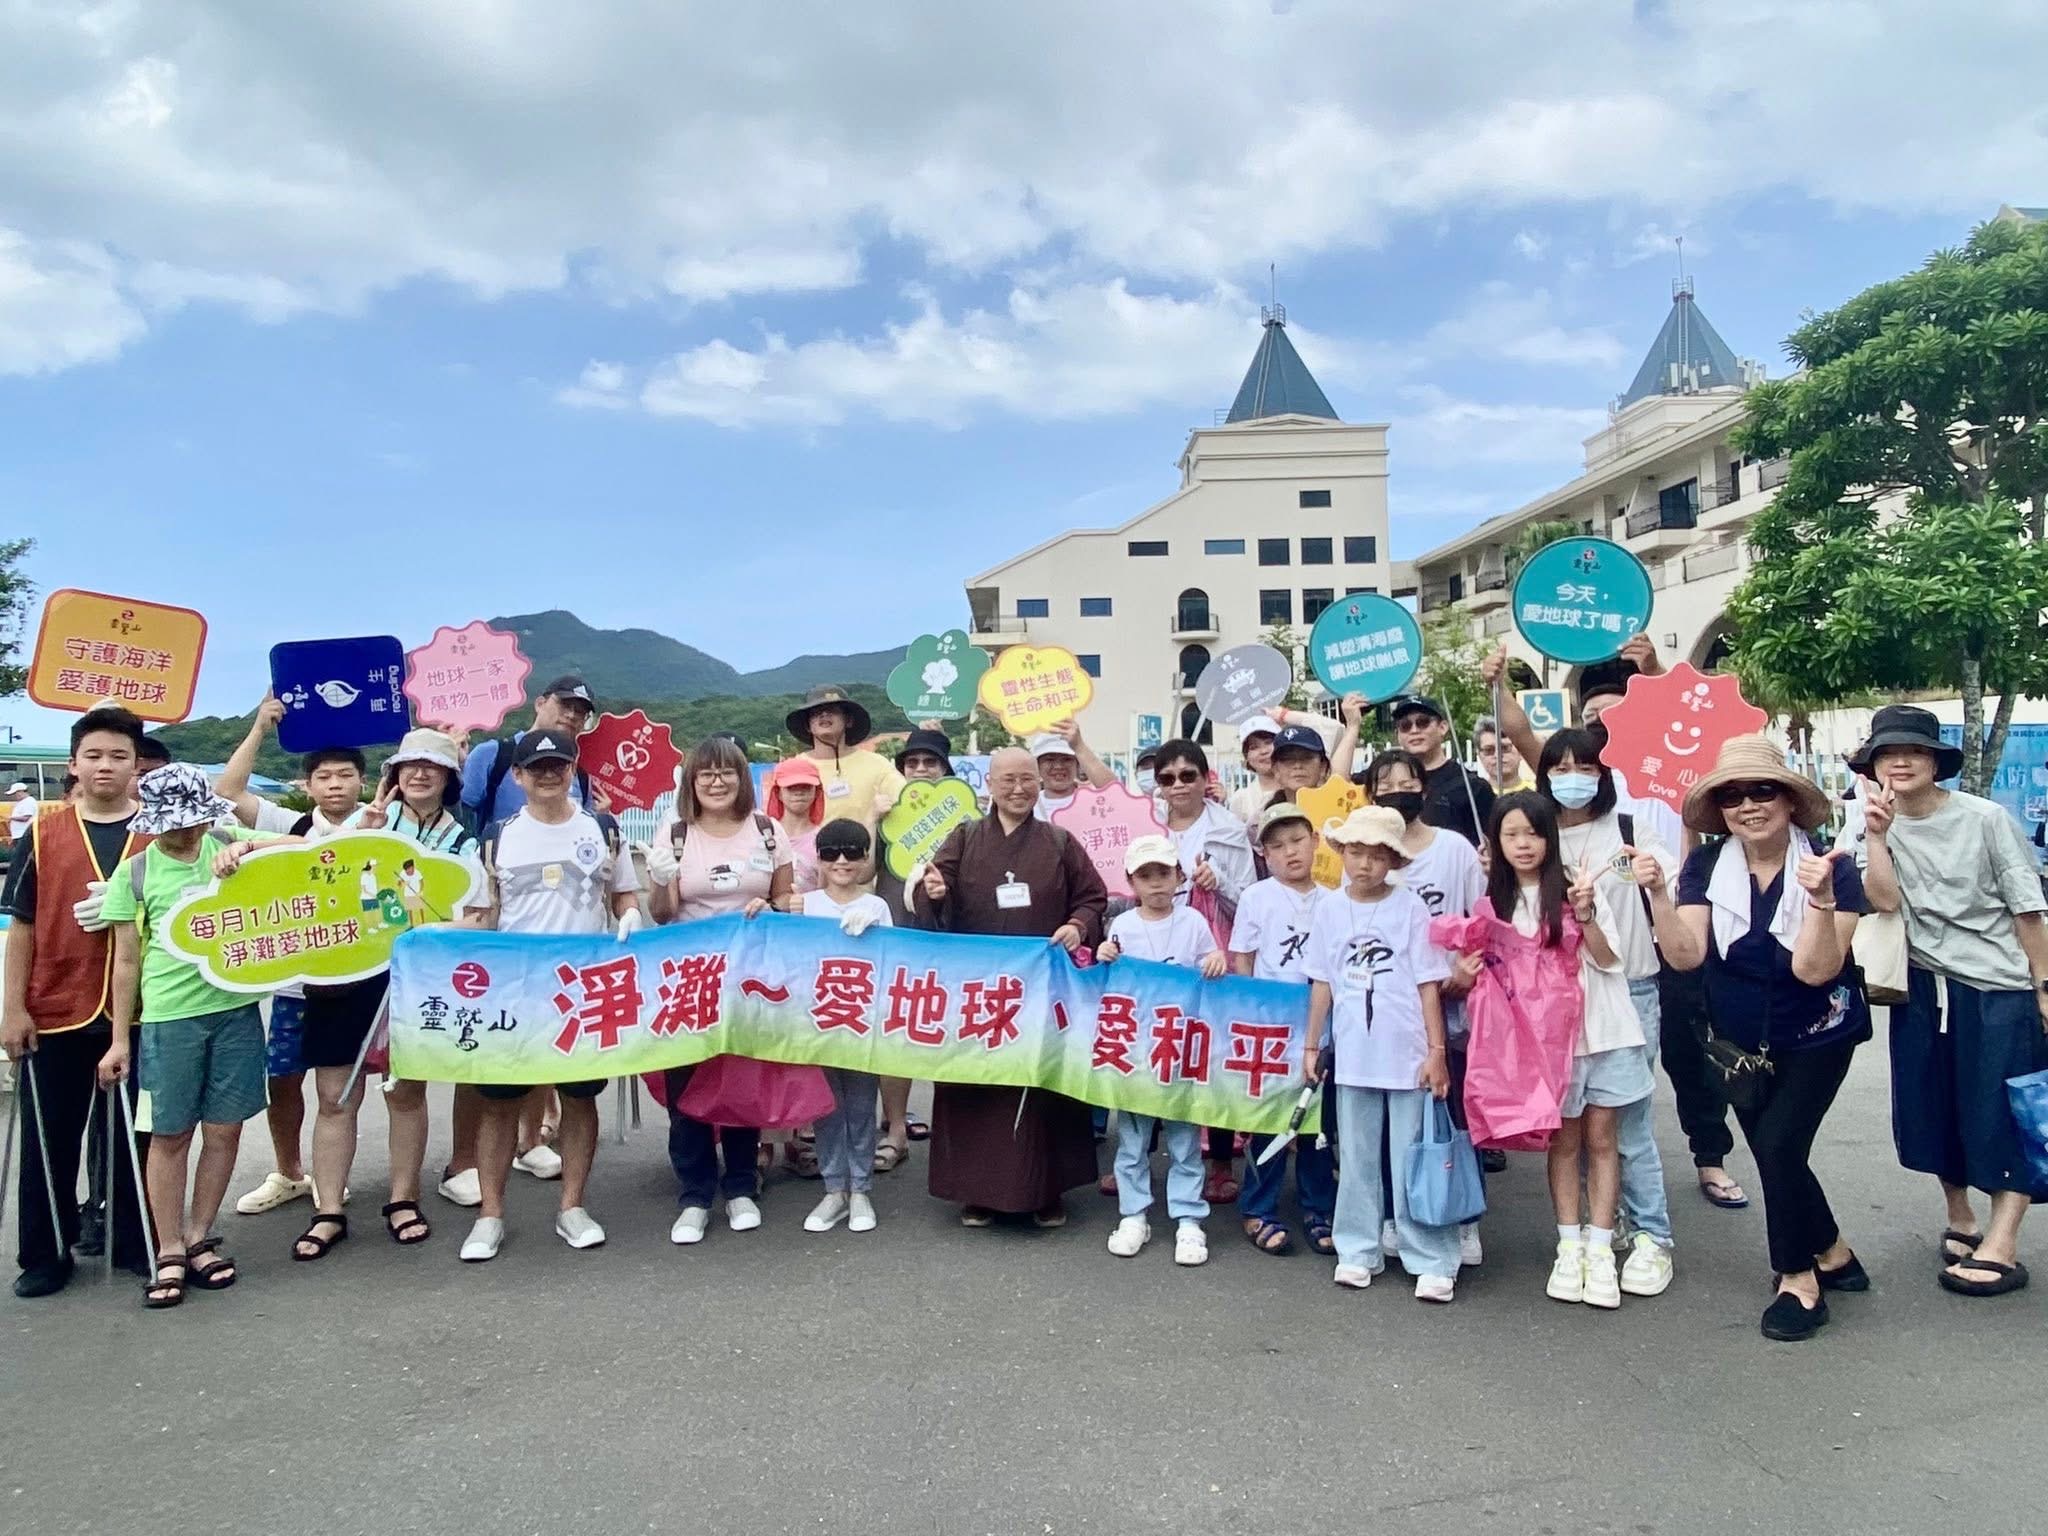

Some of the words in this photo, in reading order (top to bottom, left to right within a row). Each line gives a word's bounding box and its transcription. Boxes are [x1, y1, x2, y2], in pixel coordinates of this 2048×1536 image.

[66, 638, 173, 673] 守護海洋
[57, 669, 168, 704] 愛護地球
[368, 668, 387, 712] 再生
[388, 665, 401, 713] recycling
[427, 659, 505, 688] 地球一家
[430, 683, 510, 713] 萬物一體
[1007, 688, 1080, 717] 生命和平
[1640, 756, 1699, 788] 愛心
[1648, 780, 1678, 799] love
[1082, 825, 1129, 851] 淨灘
[223, 919, 360, 969] 淨灘愛地球
[420, 995, 518, 1052] 靈鷲山
